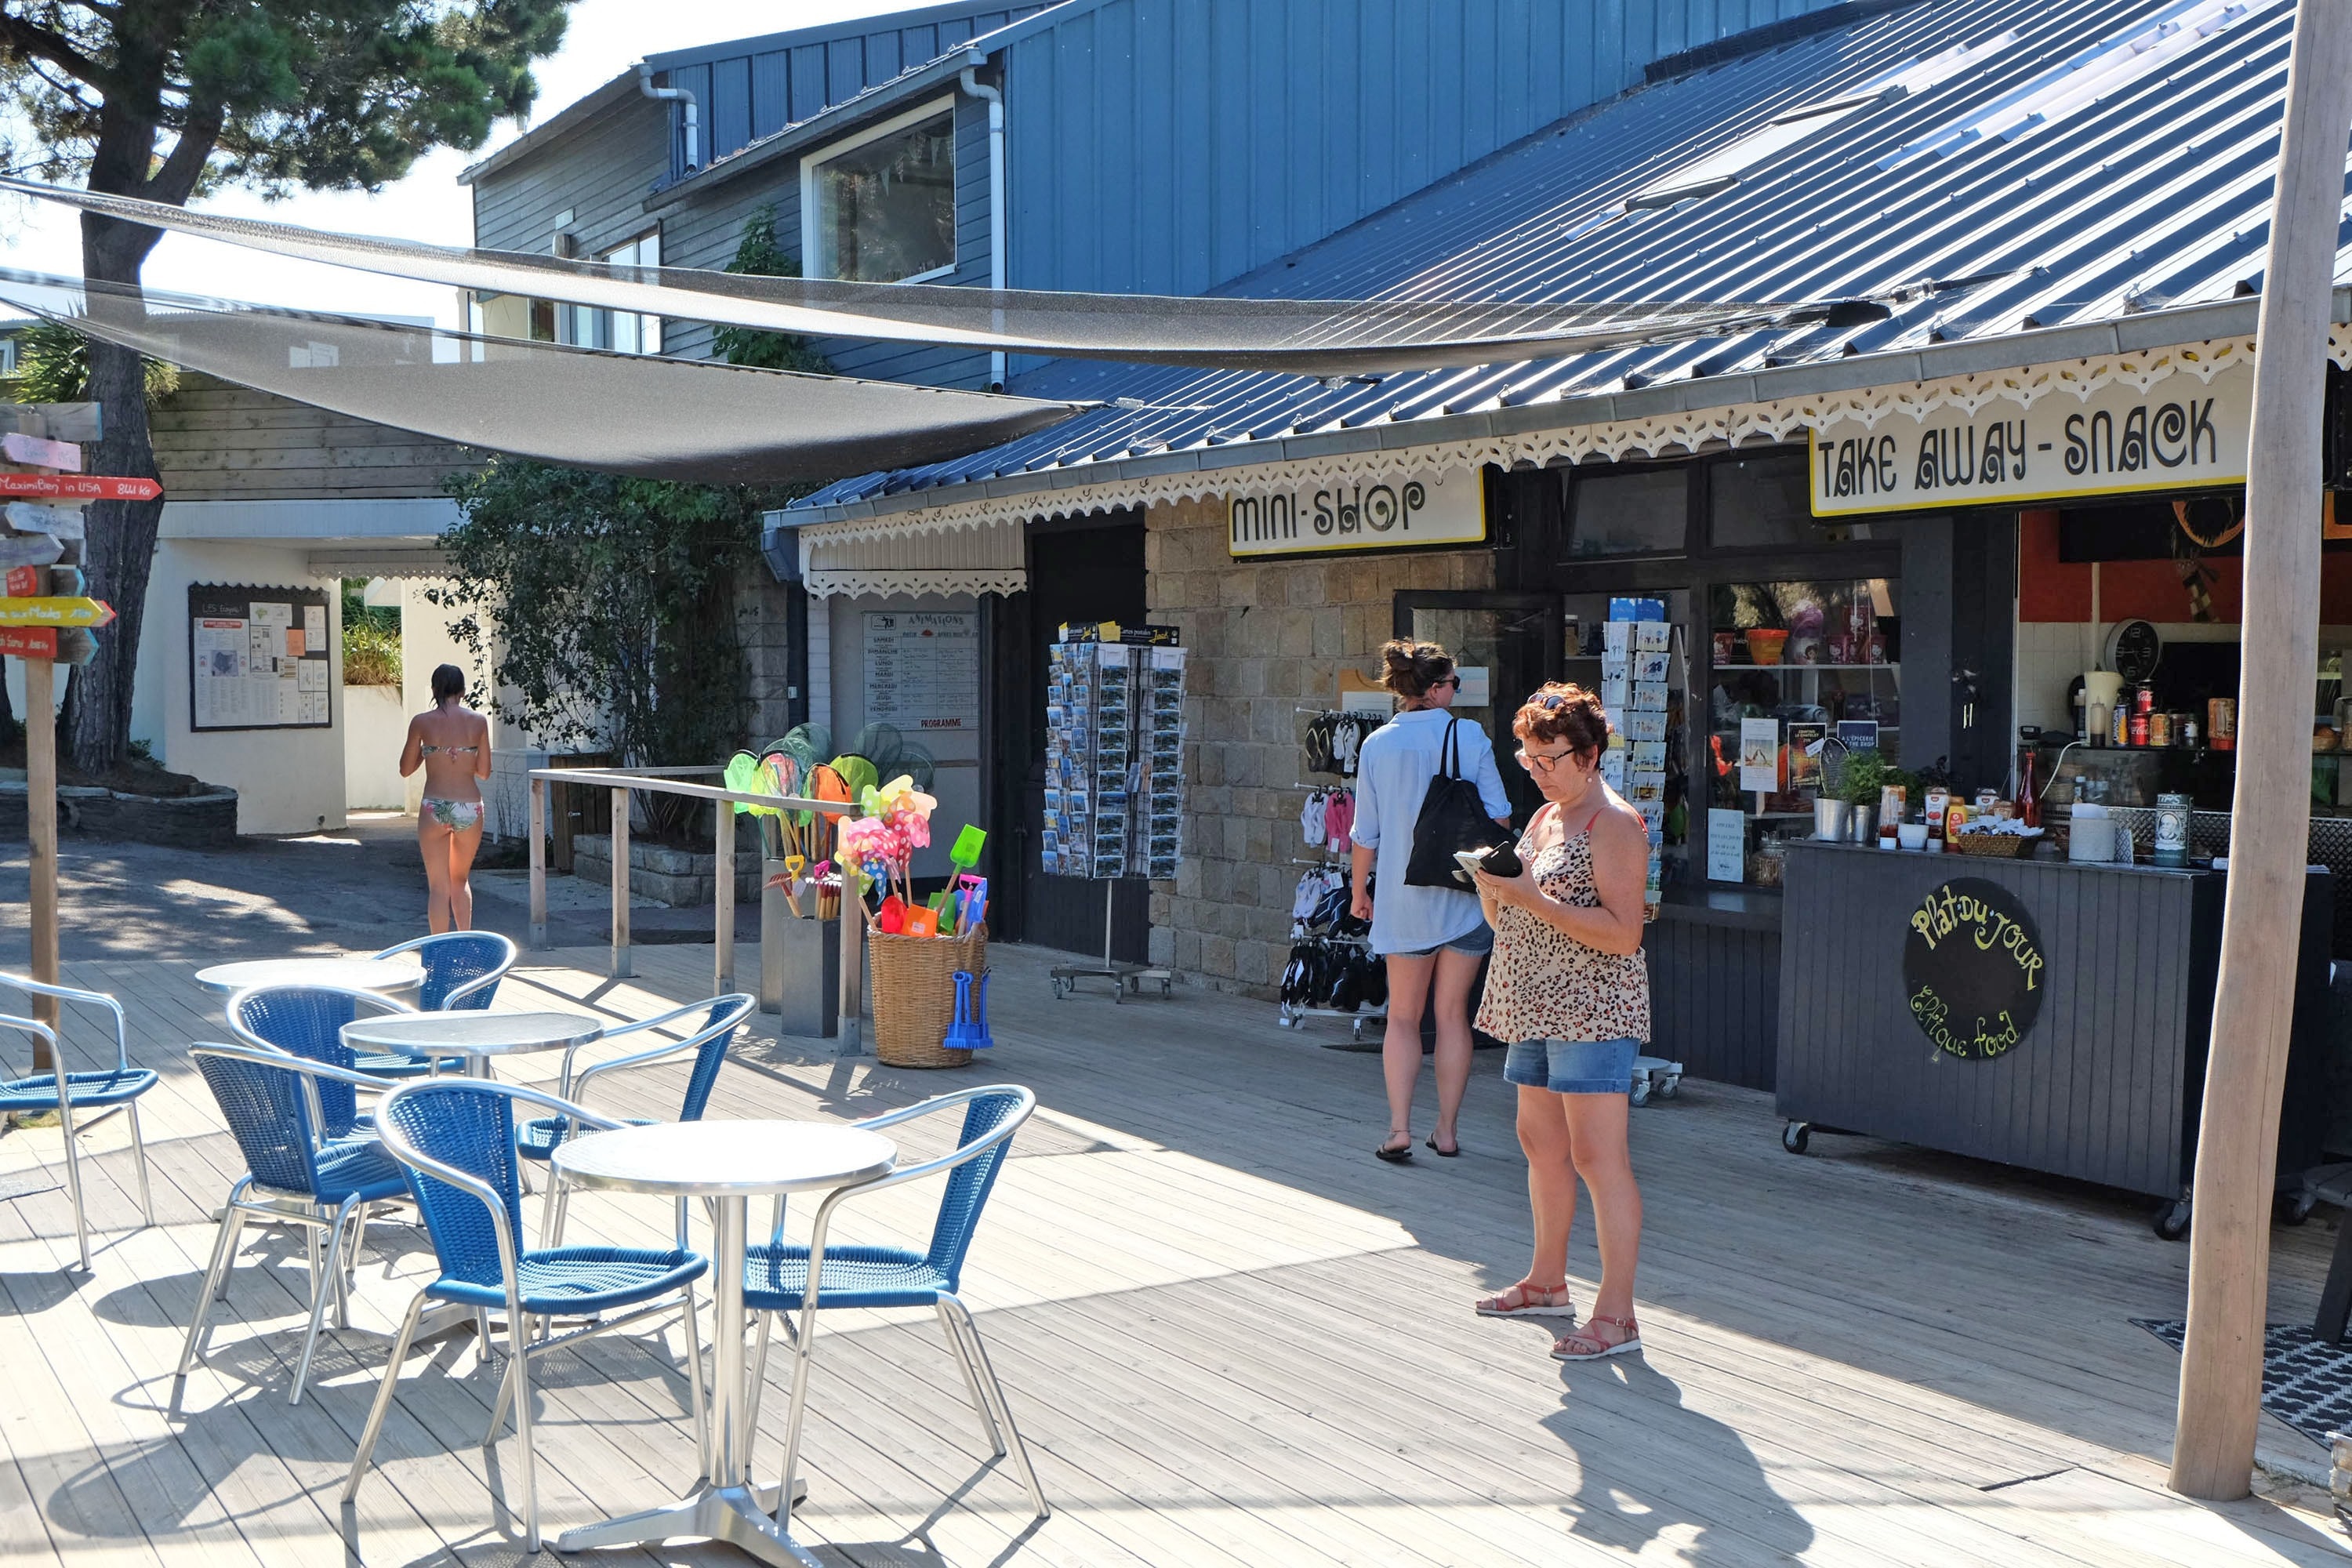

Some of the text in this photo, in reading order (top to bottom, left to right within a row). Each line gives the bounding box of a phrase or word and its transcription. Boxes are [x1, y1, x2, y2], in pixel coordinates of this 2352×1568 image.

[1818, 435, 1896, 497] TAKE
[78, 484, 101, 494] USA
[921, 718, 962, 728] PROGRAMME
[1911, 884, 1958, 950] Plat
